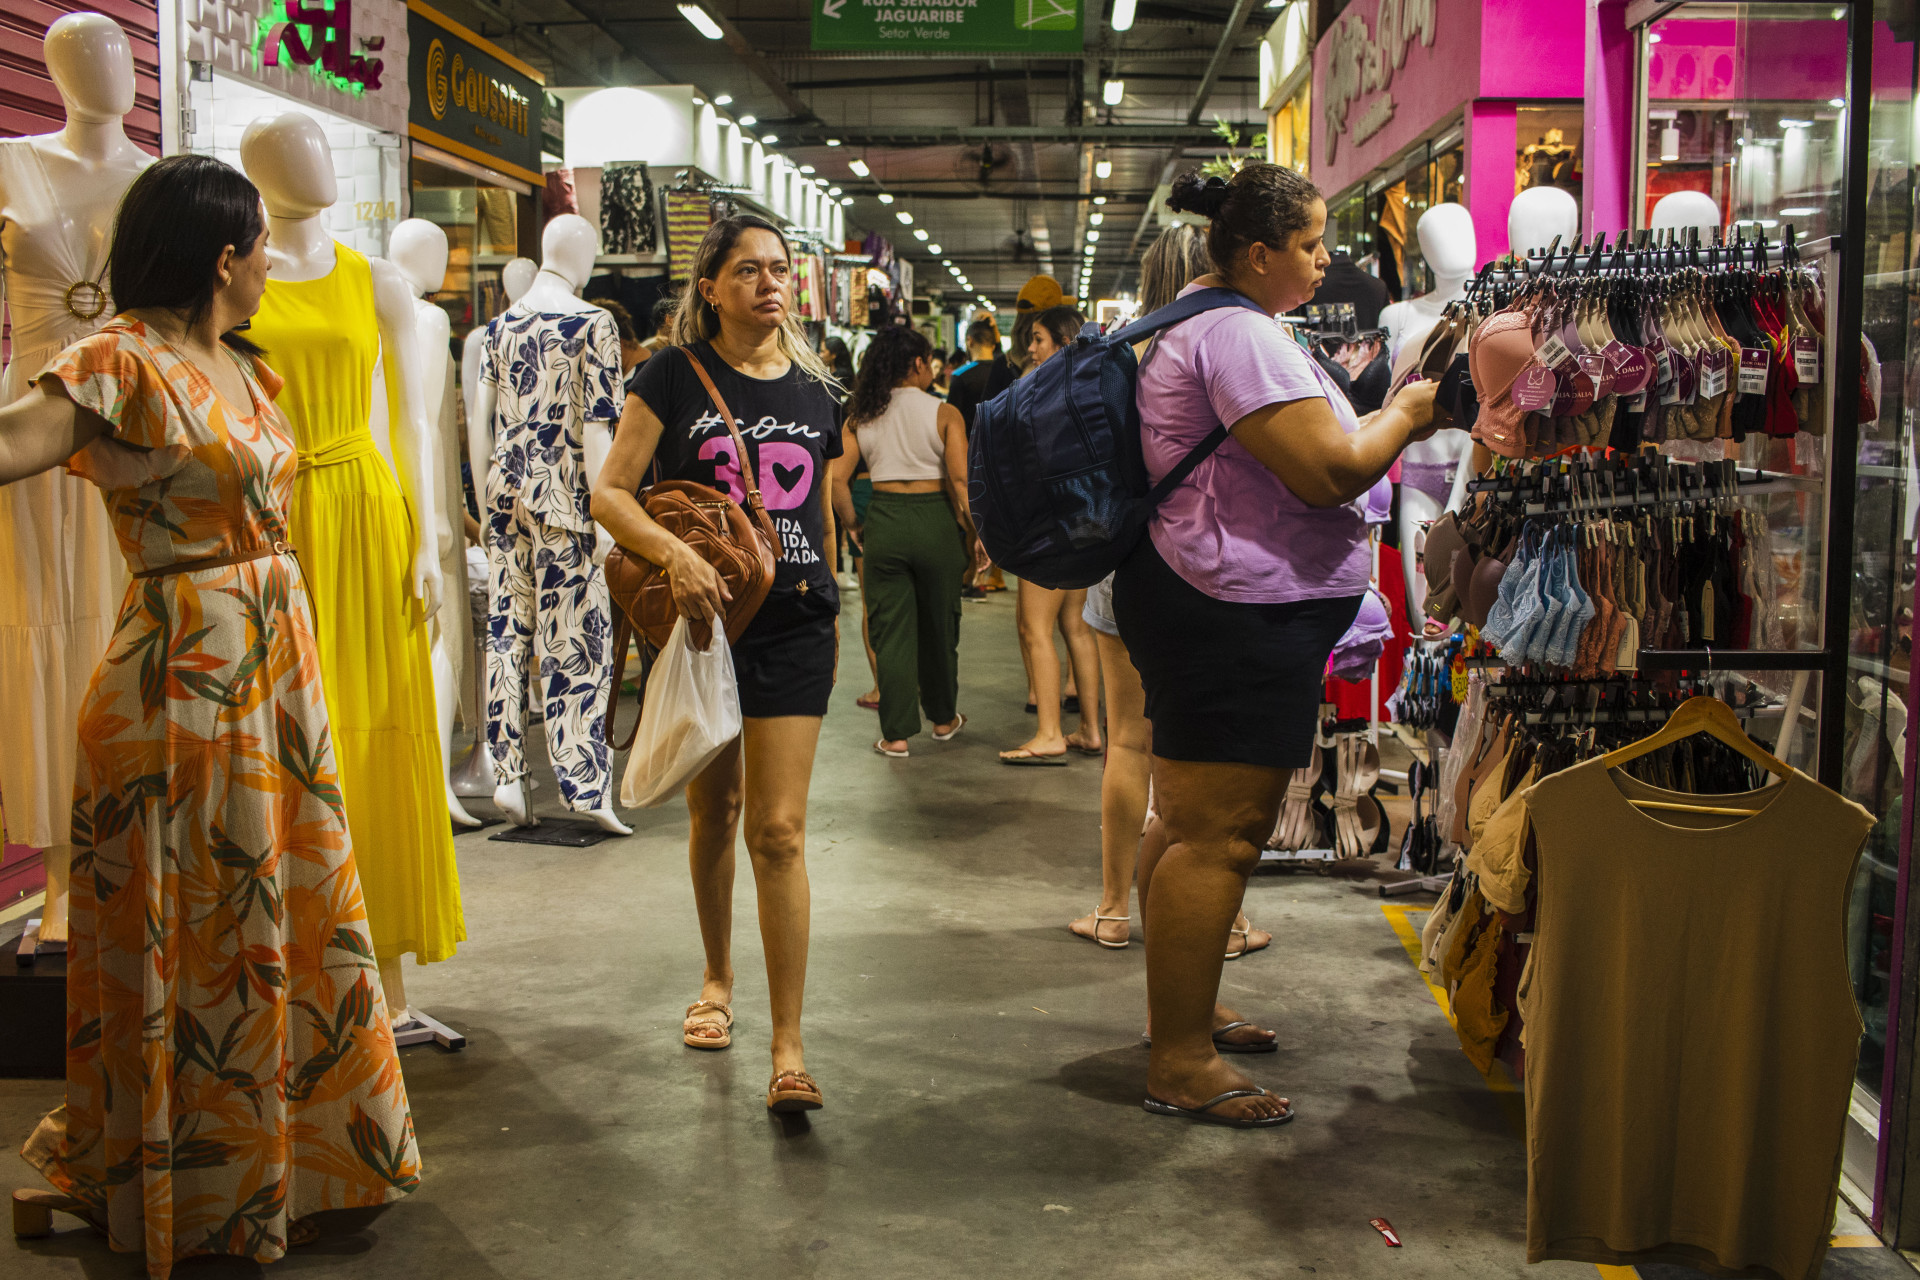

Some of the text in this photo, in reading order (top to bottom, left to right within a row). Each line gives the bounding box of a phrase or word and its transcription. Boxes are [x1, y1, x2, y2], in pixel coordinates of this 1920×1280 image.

[874, 9, 965, 23] JAGUARIBE
[878, 26, 951, 40] Setor Verde
[353, 201, 397, 221] 1244
